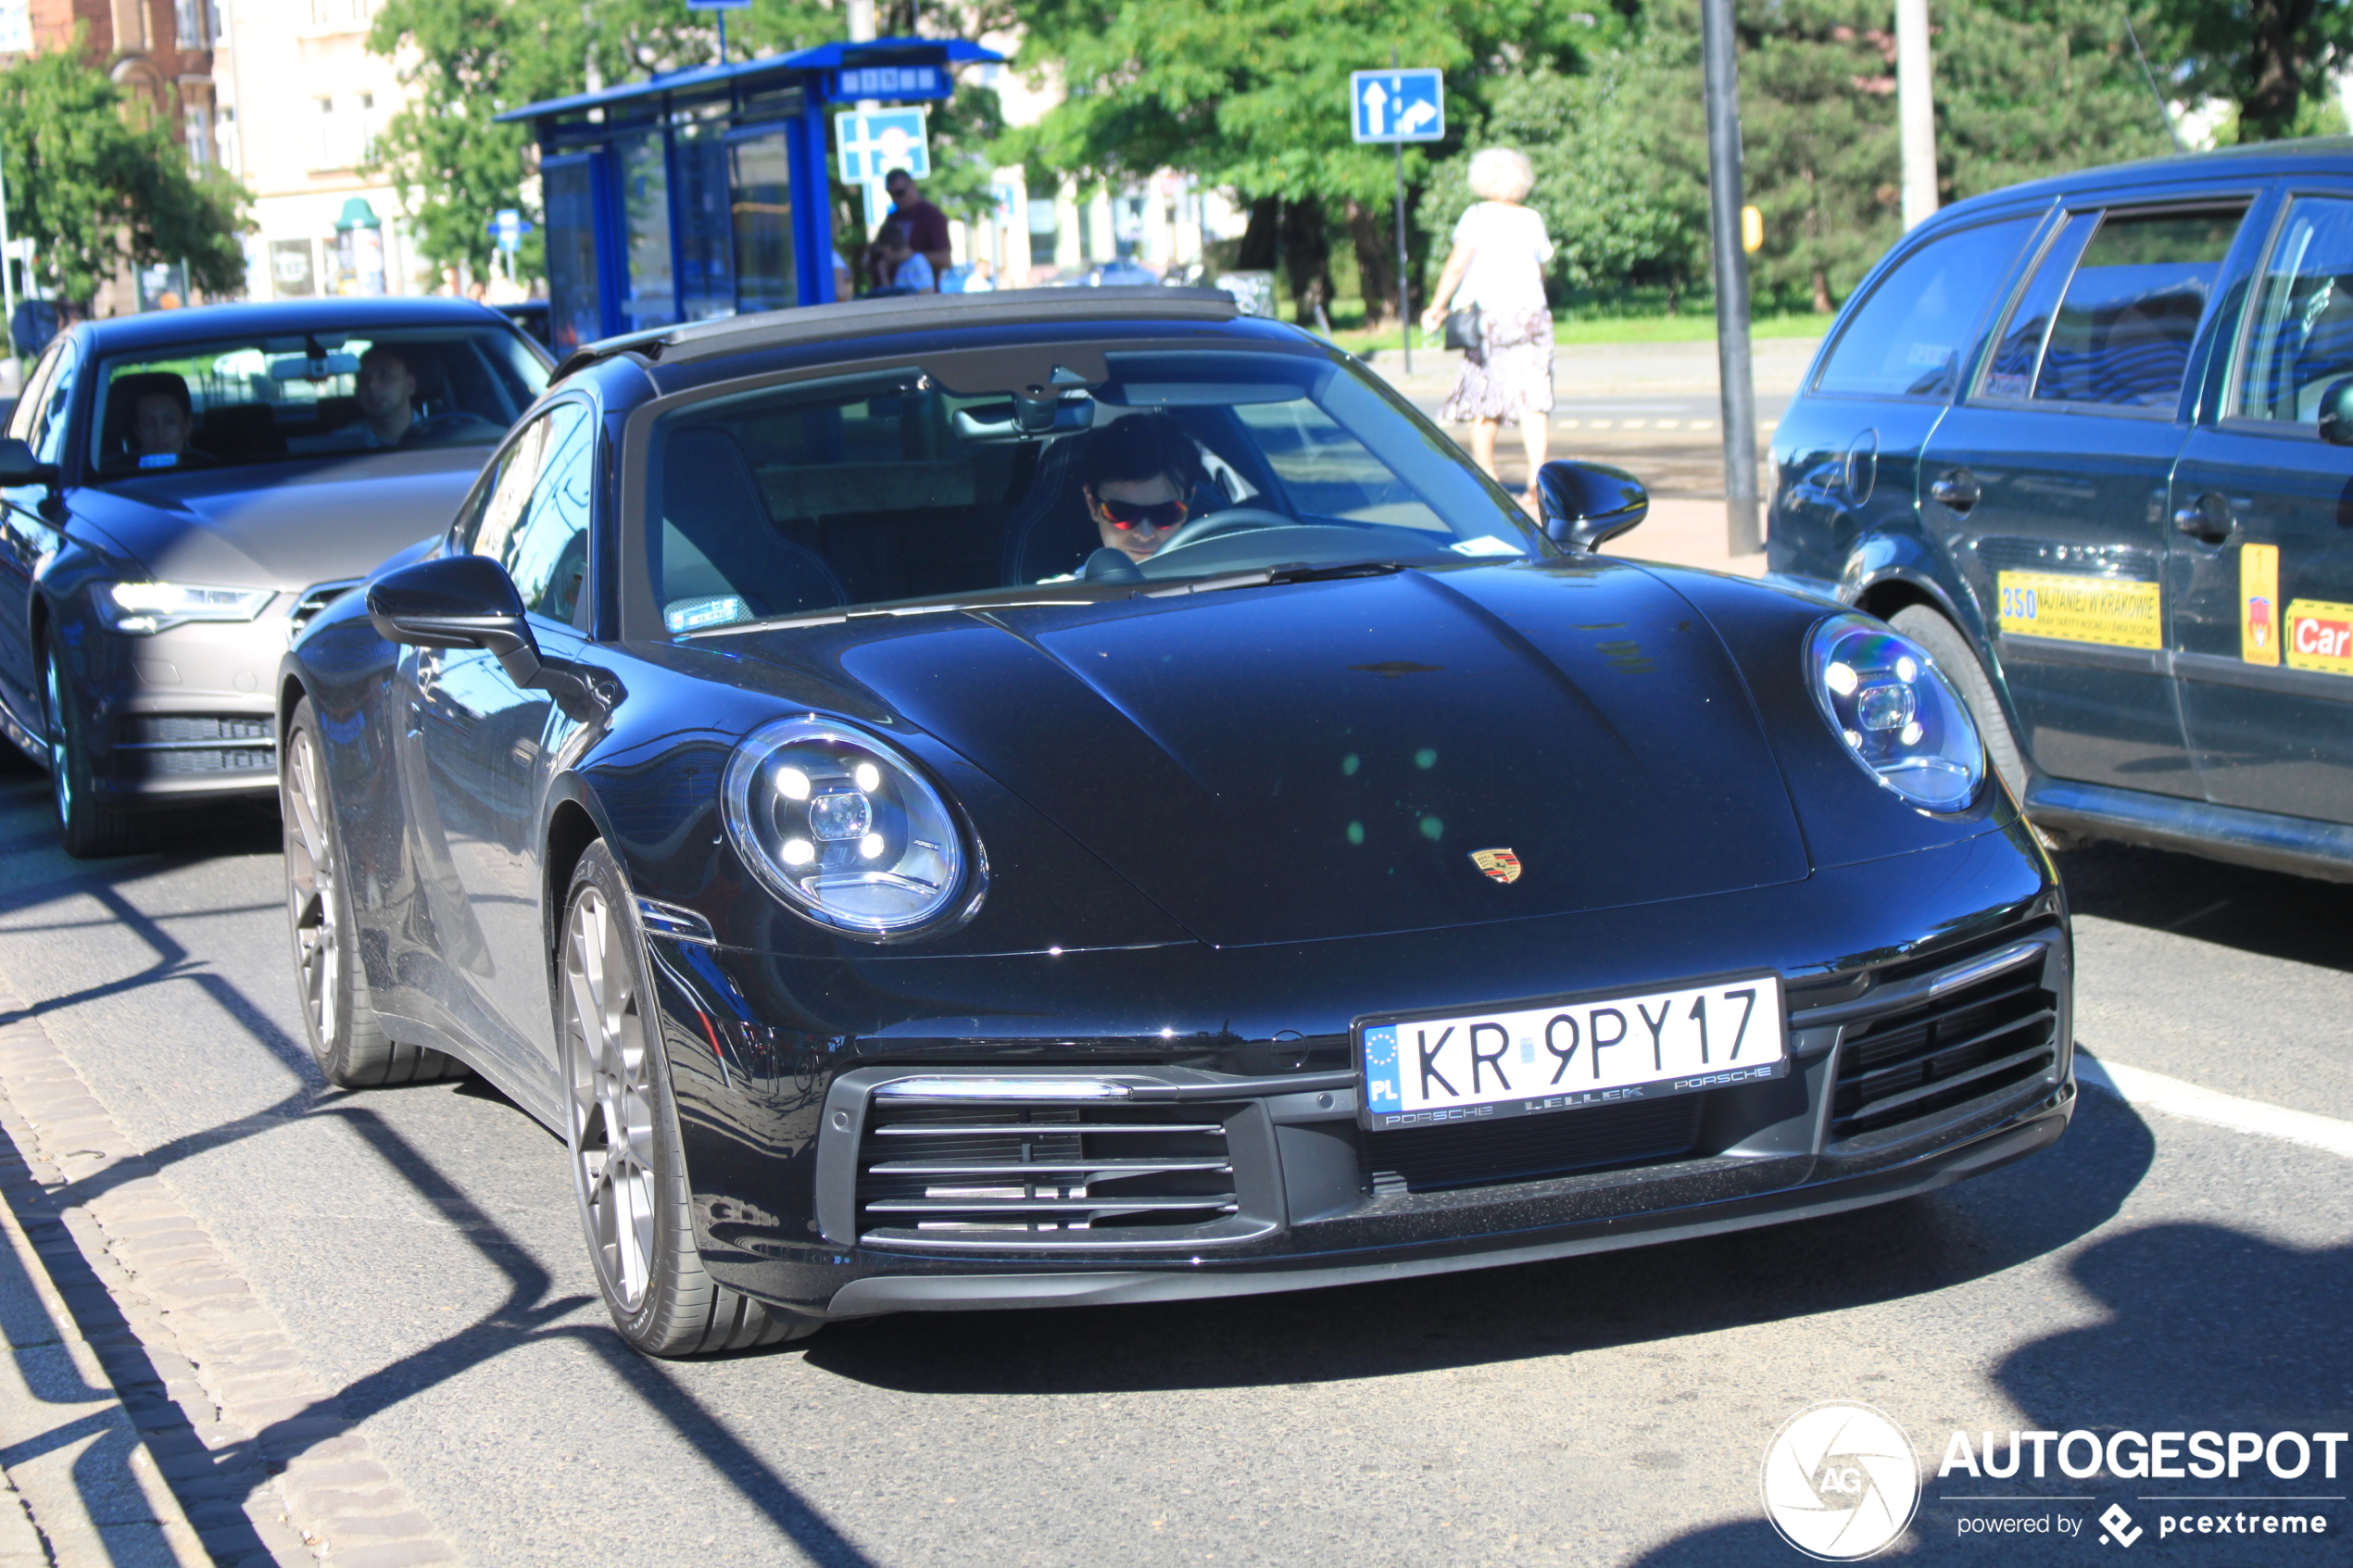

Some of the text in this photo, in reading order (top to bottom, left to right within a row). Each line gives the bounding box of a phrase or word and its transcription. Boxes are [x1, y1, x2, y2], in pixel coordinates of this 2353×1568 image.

[2003, 586, 2036, 620] 350
[2037, 586, 2087, 613] NAJTANIEJ
[2089, 591, 2099, 613] W
[2296, 618, 2351, 657] Car
[1417, 988, 1756, 1100] KR 9PY17
[1371, 1079, 1398, 1101] PL
[1385, 1066, 1772, 1126] PORSCHE LELLEK PORSCHE
